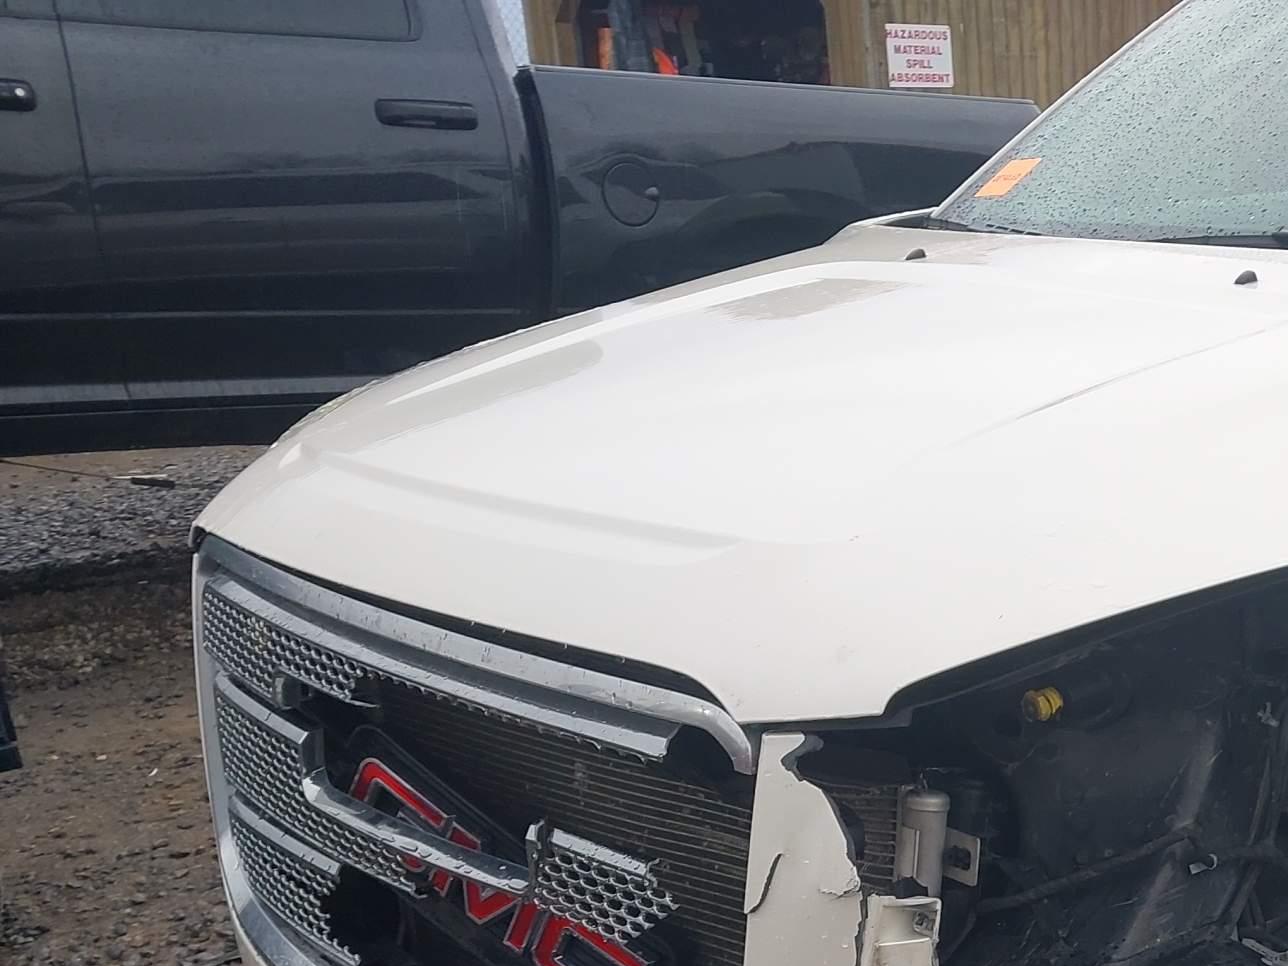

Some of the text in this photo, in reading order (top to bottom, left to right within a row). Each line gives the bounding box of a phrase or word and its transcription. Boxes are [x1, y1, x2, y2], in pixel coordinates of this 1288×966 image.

[885, 29, 948, 40] HAZARDOUS
[894, 45, 943, 55] MATERIAL
[906, 59, 933, 69] SPILL
[890, 73, 950, 83] ABSORBENT
